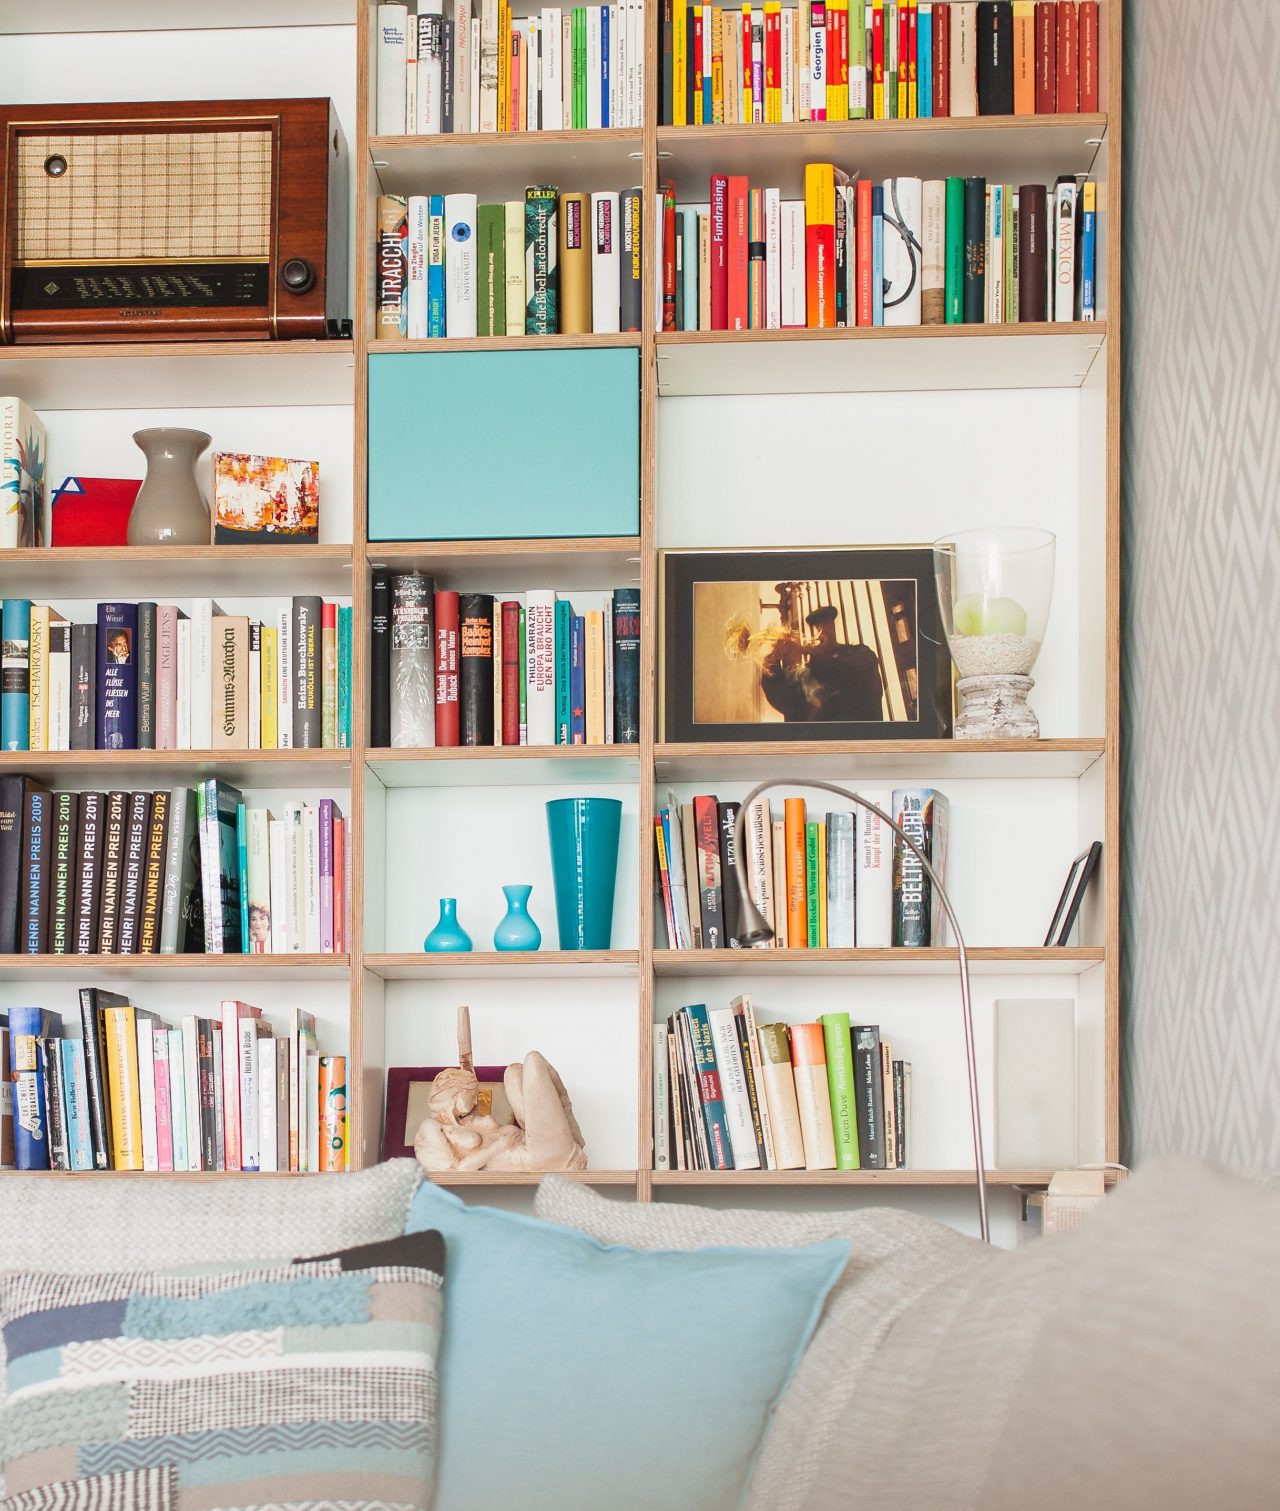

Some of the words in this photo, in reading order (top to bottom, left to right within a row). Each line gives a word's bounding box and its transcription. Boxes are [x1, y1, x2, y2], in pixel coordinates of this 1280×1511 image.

[419, 17, 432, 59] HITLER
[813, 32, 824, 80] Georgien
[753, 63, 761, 102] Amsterdam
[528, 191, 556, 199] KELLER
[535, 209, 547, 238] recht
[625, 197, 633, 235] HERRMANN
[714, 180, 726, 242] Fundraising
[535, 240, 547, 259] doch
[625, 234, 633, 252] HORST
[1059, 223, 1072, 284] MEXICO
[382, 232, 403, 325] BELTRACCHI
[535, 260, 547, 278] hat
[535, 278, 547, 306] Bibel
[535, 305, 547, 321] die
[535, 322, 547, 336] nd
[161, 612, 171, 639] JENS
[439, 629, 447, 639] Tod
[537, 605, 545, 650] BRAUCHT
[545, 605, 553, 635] NICHT
[298, 606, 310, 677] Buschkowsky
[307, 624, 315, 660] ÜBERALL
[439, 640, 447, 660] zweite
[448, 631, 456, 649] Vaters
[545, 637, 553, 663] EURO
[31, 618, 42, 710] TSCHAIKOWSKY
[161, 644, 171, 670] INGE
[222, 628, 237, 683] Märchen
[307, 661, 315, 670] IST
[439, 661, 447, 671] Der
[448, 650, 456, 671] meines
[105, 669, 119, 677] ALLE
[105, 678, 124, 687] FLÜSSE
[447, 675, 458, 701] Buback
[537, 654, 545, 692] EUROPA
[545, 665, 553, 685] DEN
[140, 682, 150, 703] Wulff
[298, 679, 307, 710] Heinz
[307, 672, 315, 710] NEUKÖLLN
[438, 675, 447, 704] Michael
[105, 710, 120, 718] MEER
[140, 704, 150, 732] Bettina
[222, 683, 237, 737] Grimms
[31, 718, 41, 750] Pahlen
[31, 795, 43, 822] 2009
[59, 795, 71, 821] 2010
[86, 795, 98, 821] 2011
[111, 794, 123, 820] 2014
[133, 795, 145, 820] 2013
[154, 795, 167, 821] 2012
[30, 825, 42, 861] PREIS
[58, 823, 70, 858] PREIS
[83, 823, 96, 859] PREIS
[107, 823, 121, 858] PREIS
[128, 825, 142, 859] PREIS
[149, 824, 163, 859] PREIS
[29, 864, 41, 916] NANNEN
[56, 863, 68, 916] NANNEN
[81, 863, 94, 916] NANNEN
[104, 862, 118, 915] NANNEN
[124, 863, 139, 915] NANNEN
[145, 862, 159, 914] NANNEN
[27, 919, 39, 955] HENRI
[54, 919, 66, 955] HENRI
[78, 919, 91, 955] HENRI
[101, 918, 114, 954] HENRI
[121, 919, 132, 955] HENRI
[142, 917, 154, 954] HENRI
[701, 1023, 712, 1046] Nazis
[705, 1048, 715, 1063] der
[839, 1094, 849, 1118] Duve
[840, 1120, 851, 1145] Karen
